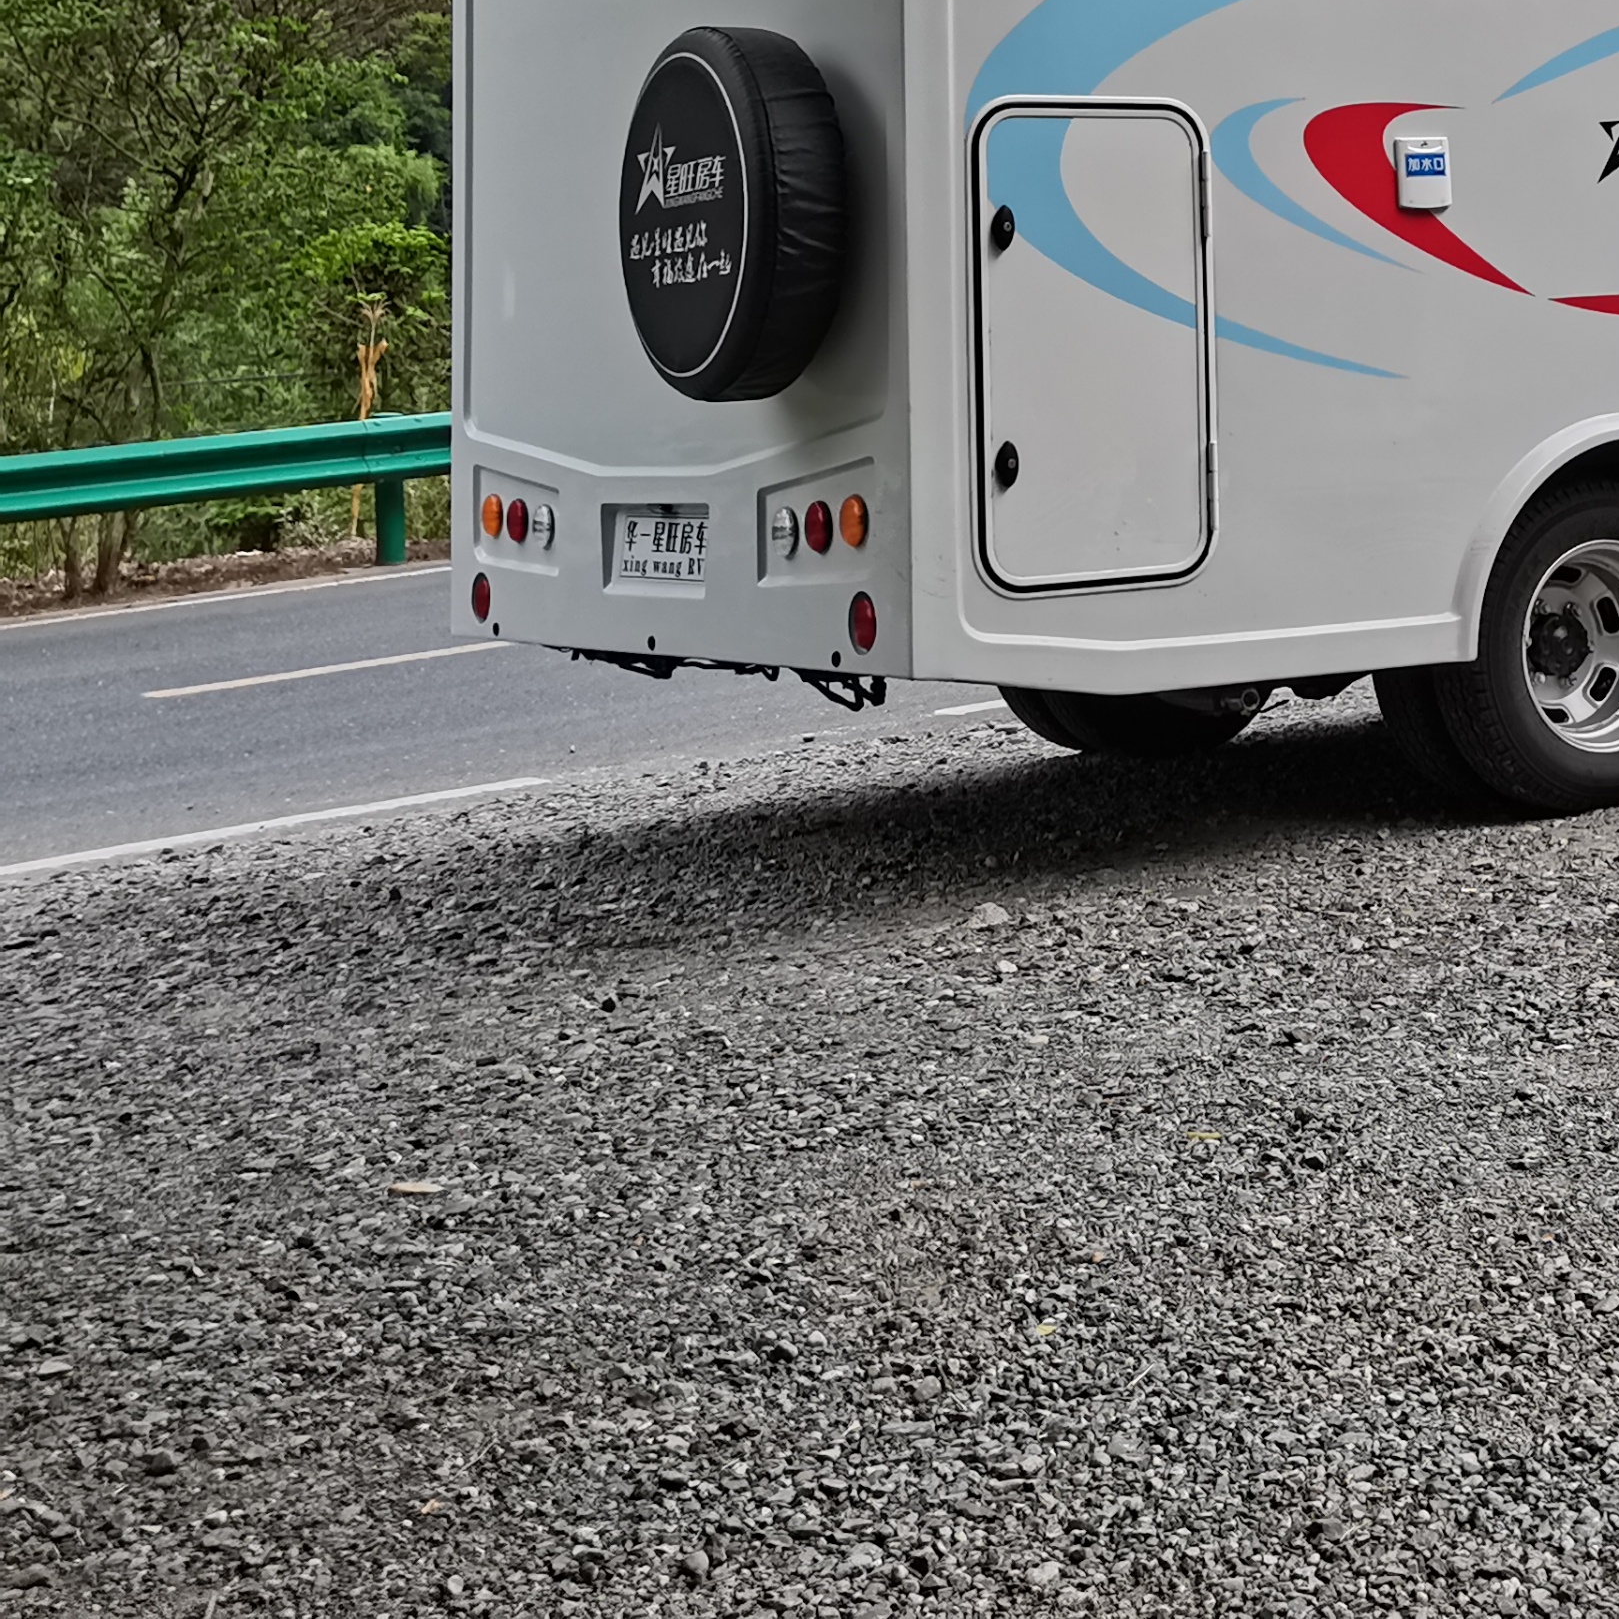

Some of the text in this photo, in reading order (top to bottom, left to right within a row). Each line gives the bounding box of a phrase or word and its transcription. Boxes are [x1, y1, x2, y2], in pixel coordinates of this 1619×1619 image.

[664, 155, 726, 197] 星旺房车
[1407, 157, 1445, 172] 加水口
[625, 521, 709, 555] 华一星旺房车
[622, 555, 649, 577] xing
[653, 561, 683, 578] wang
